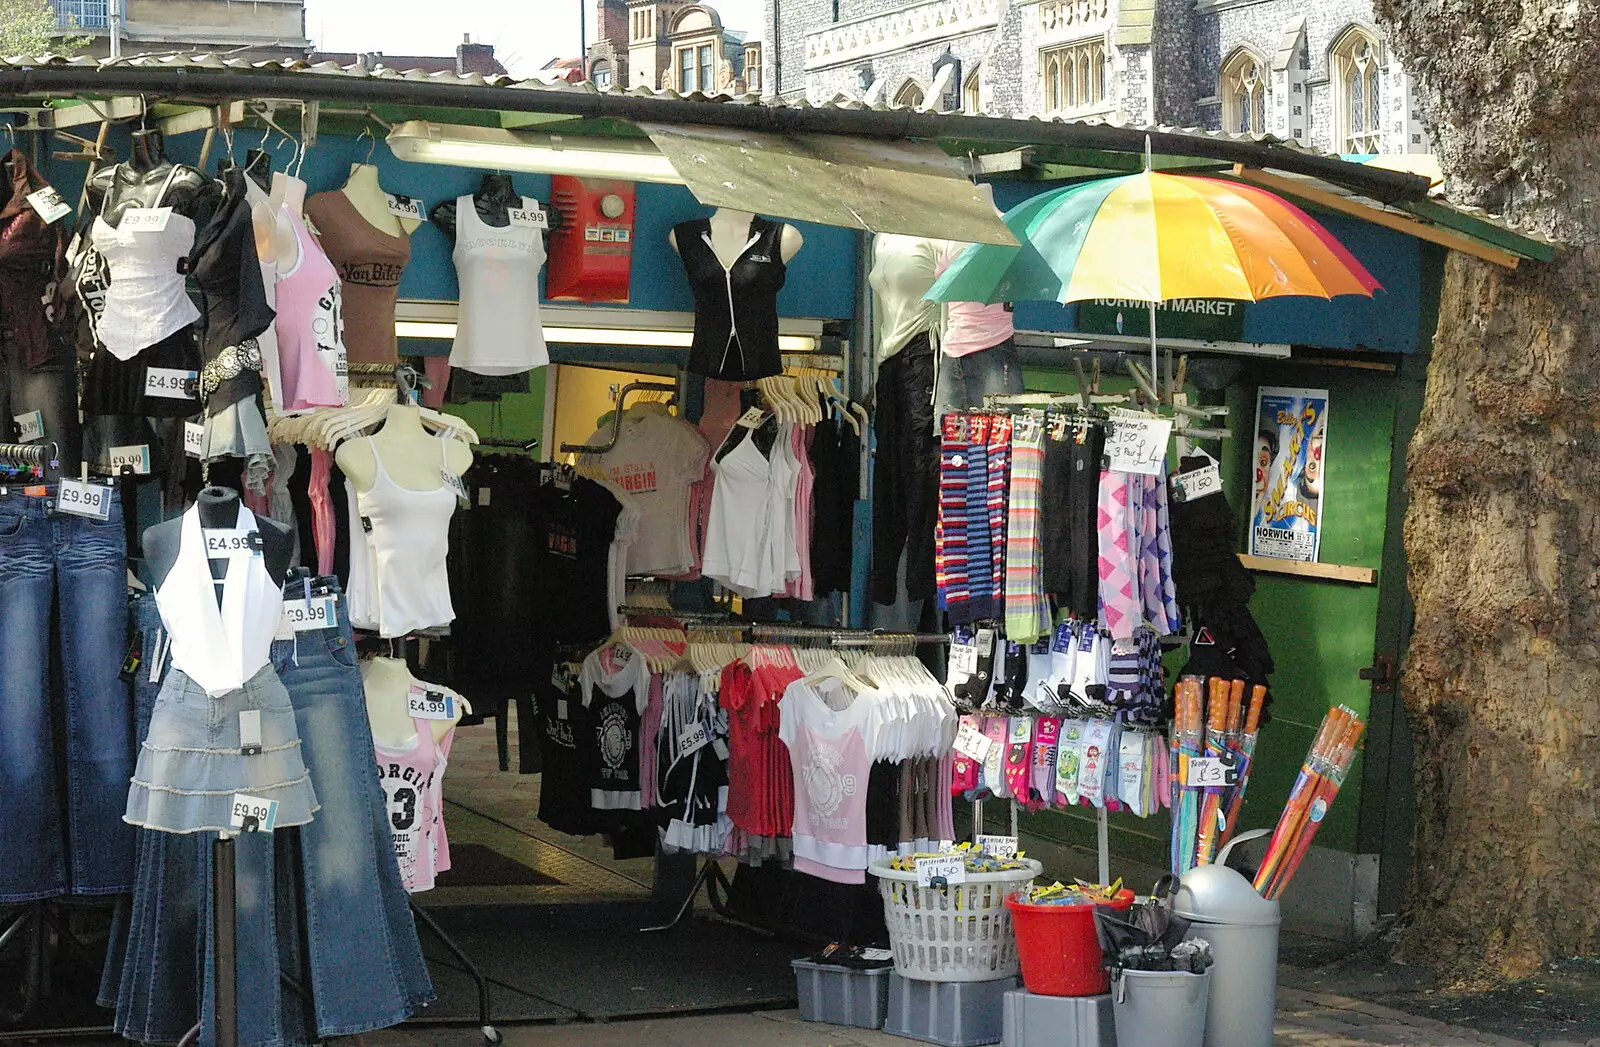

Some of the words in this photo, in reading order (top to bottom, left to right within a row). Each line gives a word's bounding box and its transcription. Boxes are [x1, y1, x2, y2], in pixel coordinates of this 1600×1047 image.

[388, 200, 418, 214] £4.99
[513, 211, 544, 222] £4.99
[1172, 300, 1236, 316] MARKET
[148, 375, 187, 390] £4.99
[1276, 410, 1297, 425] Billy
[22, 420, 38, 436] 9.99
[1113, 446, 1121, 458] 3
[112, 454, 142, 469] £9.99
[62, 488, 100, 506] £9.99
[1276, 501, 1317, 527] CIRCUS
[1256, 527, 1295, 541] NORWICH
[208, 537, 249, 550] £4.99
[287, 606, 325, 622] £9.99
[410, 699, 445, 713] £4.99
[682, 729, 706, 751] £5.99
[378, 763, 425, 796] ORGIA
[1197, 768, 1221, 784] £3
[233, 802, 268, 821] £9.99
[386, 788, 416, 831] 3
